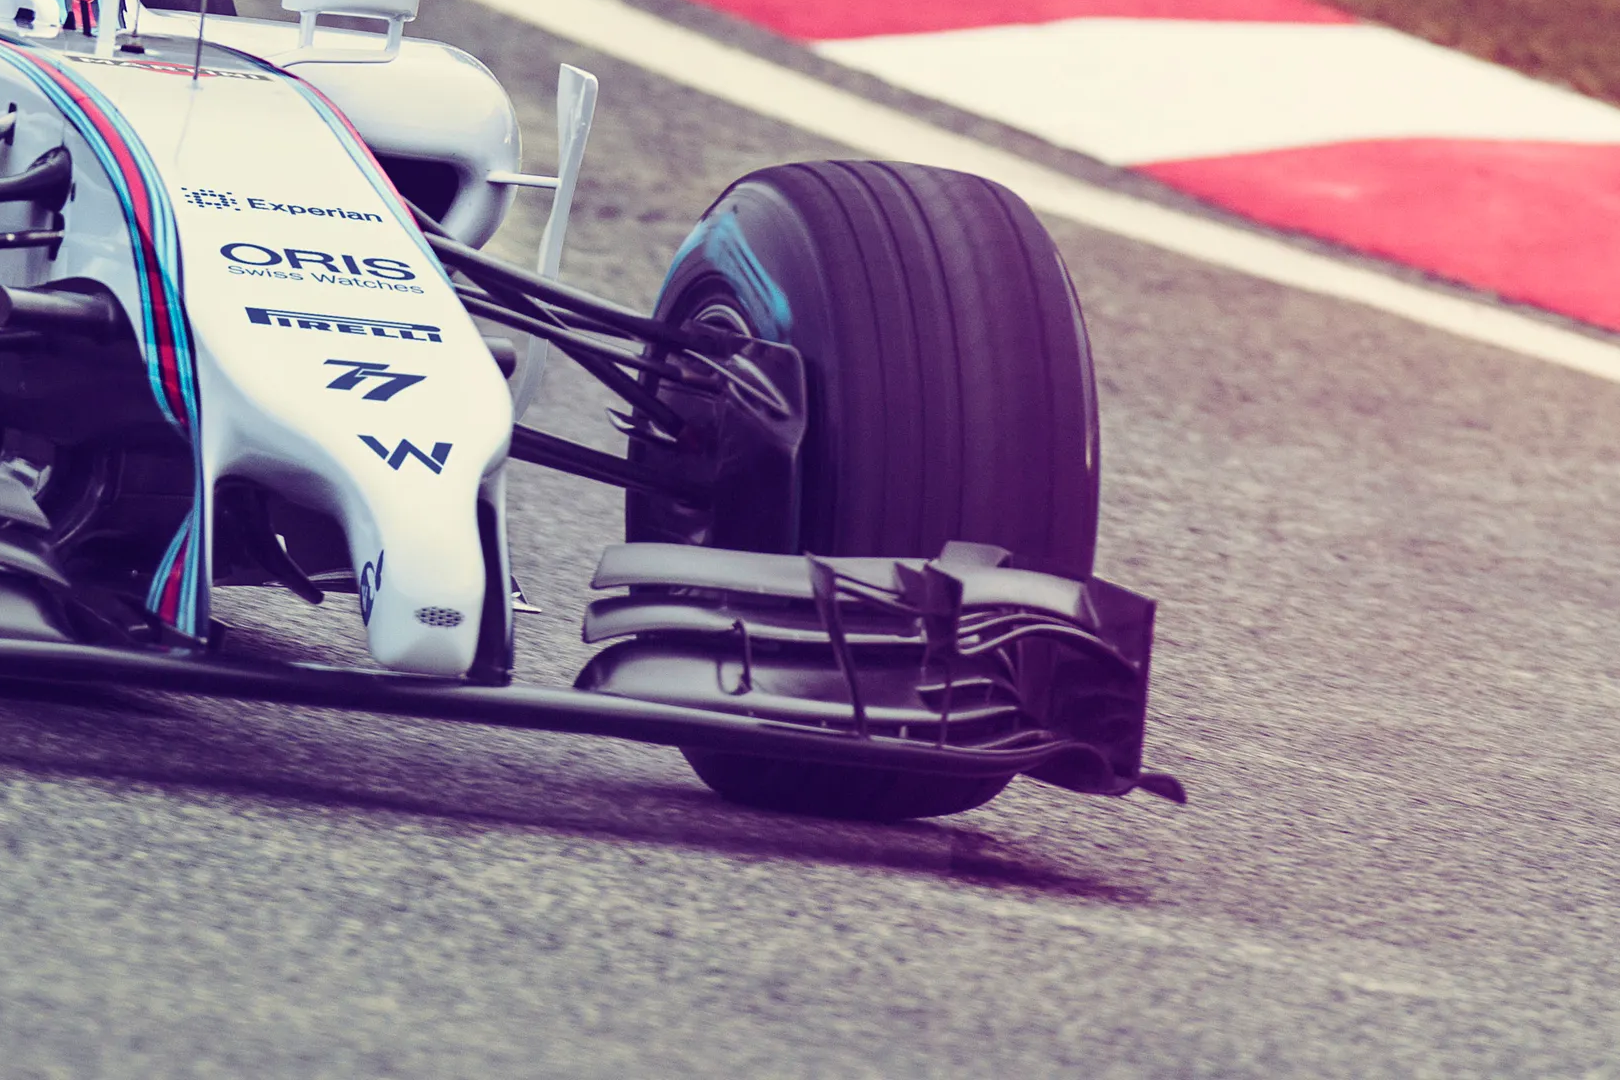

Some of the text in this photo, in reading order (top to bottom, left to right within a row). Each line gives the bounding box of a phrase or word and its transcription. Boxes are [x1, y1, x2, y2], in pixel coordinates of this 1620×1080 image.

[246, 197, 383, 223] Experian
[219, 242, 417, 281] ORIS
[227, 264, 425, 295] Swiss Watches
[244, 306, 443, 343] PIRELLI
[323, 359, 428, 402] 77
